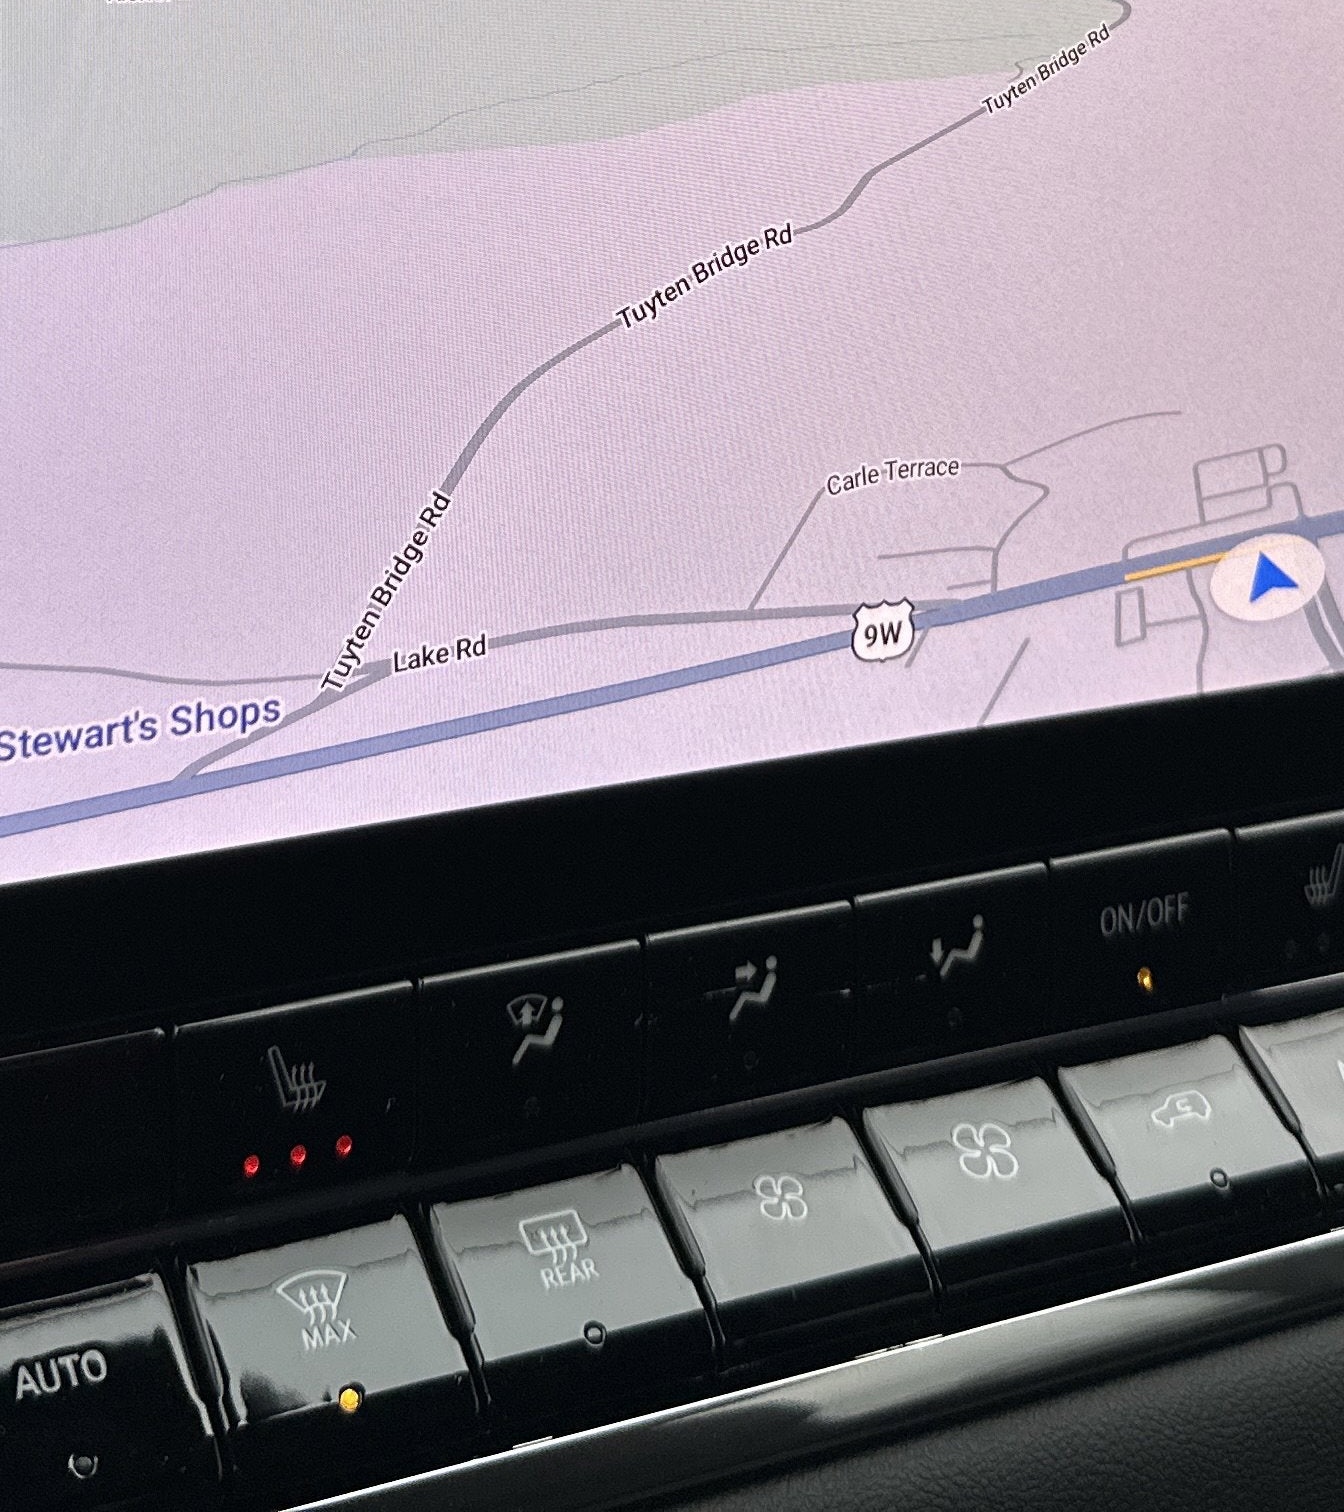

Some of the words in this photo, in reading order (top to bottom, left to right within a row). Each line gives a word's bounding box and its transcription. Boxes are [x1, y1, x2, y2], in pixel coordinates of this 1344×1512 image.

[981, 76, 1037, 114] Tuyten
[1037, 42, 1088, 81] Bridge
[1087, 23, 1110, 48] Rd
[615, 277, 691, 329] Tuyten
[691, 238, 760, 284] Bridge
[763, 222, 793, 250] Rd
[826, 464, 880, 497] Carle
[885, 457, 960, 483] Terrace
[320, 609, 381, 689] Tuyten
[369, 529, 429, 607] Bridge
[419, 490, 452, 528] Rd
[393, 644, 450, 673] Lake
[456, 632, 486, 660] Rd
[864, 621, 902, 647] 9W
[169, 695, 282, 738] Shops
[1100, 891, 1190, 937] ON/OFF
[540, 1256, 600, 1290] REAR
[302, 1317, 357, 1351] MAX
[14, 1349, 109, 1402] AUTO
